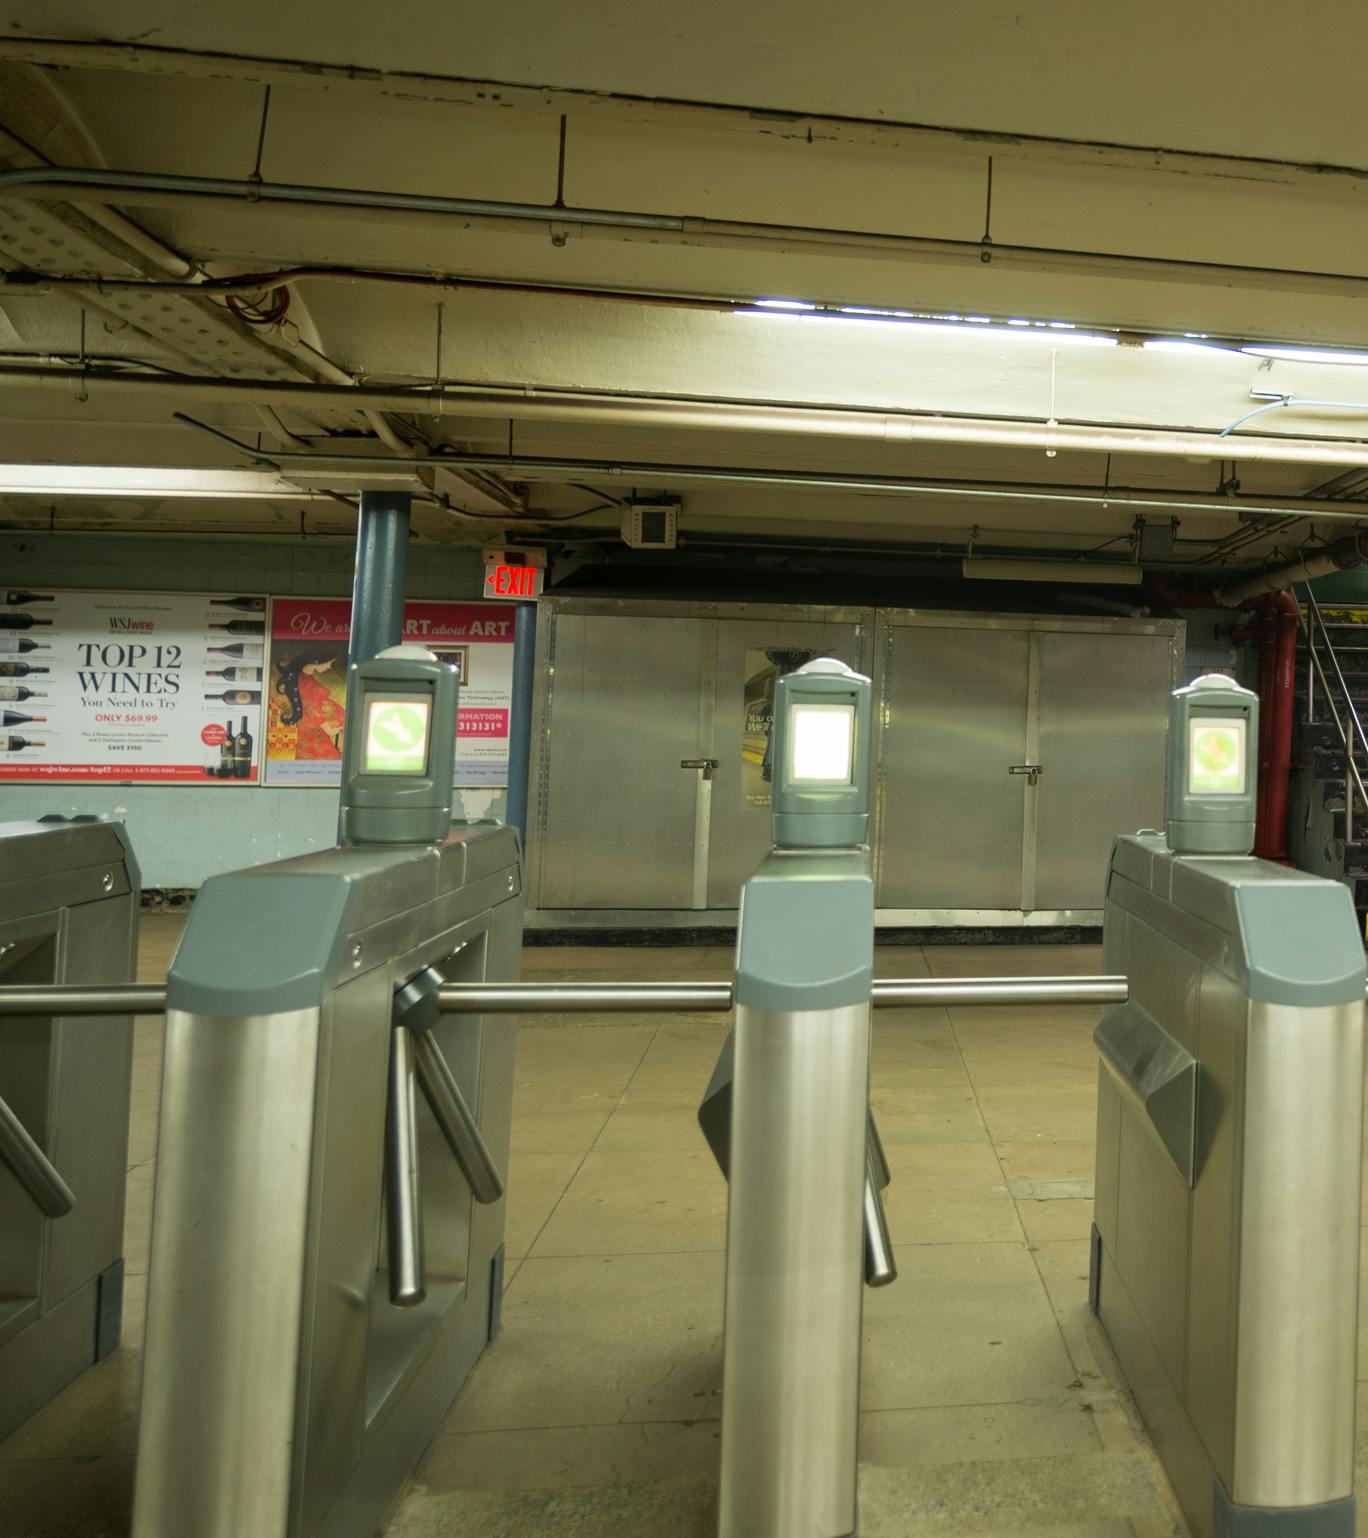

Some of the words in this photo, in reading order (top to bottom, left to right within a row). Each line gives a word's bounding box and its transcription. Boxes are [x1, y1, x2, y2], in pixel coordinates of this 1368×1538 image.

[495, 565, 538, 597] EXIT
[290, 612, 330, 636] We
[431, 623, 466, 636] about
[468, 620, 510, 636] ART
[78, 643, 147, 668] TOP
[153, 645, 183, 668] 12
[77, 671, 180, 694] WINES
[81, 697, 103, 707] You
[107, 698, 137, 708] Need
[141, 699, 154, 707] to
[157, 698, 177, 710] Try
[95, 714, 122, 722] ONLY
[125, 714, 158, 722] $69.99
